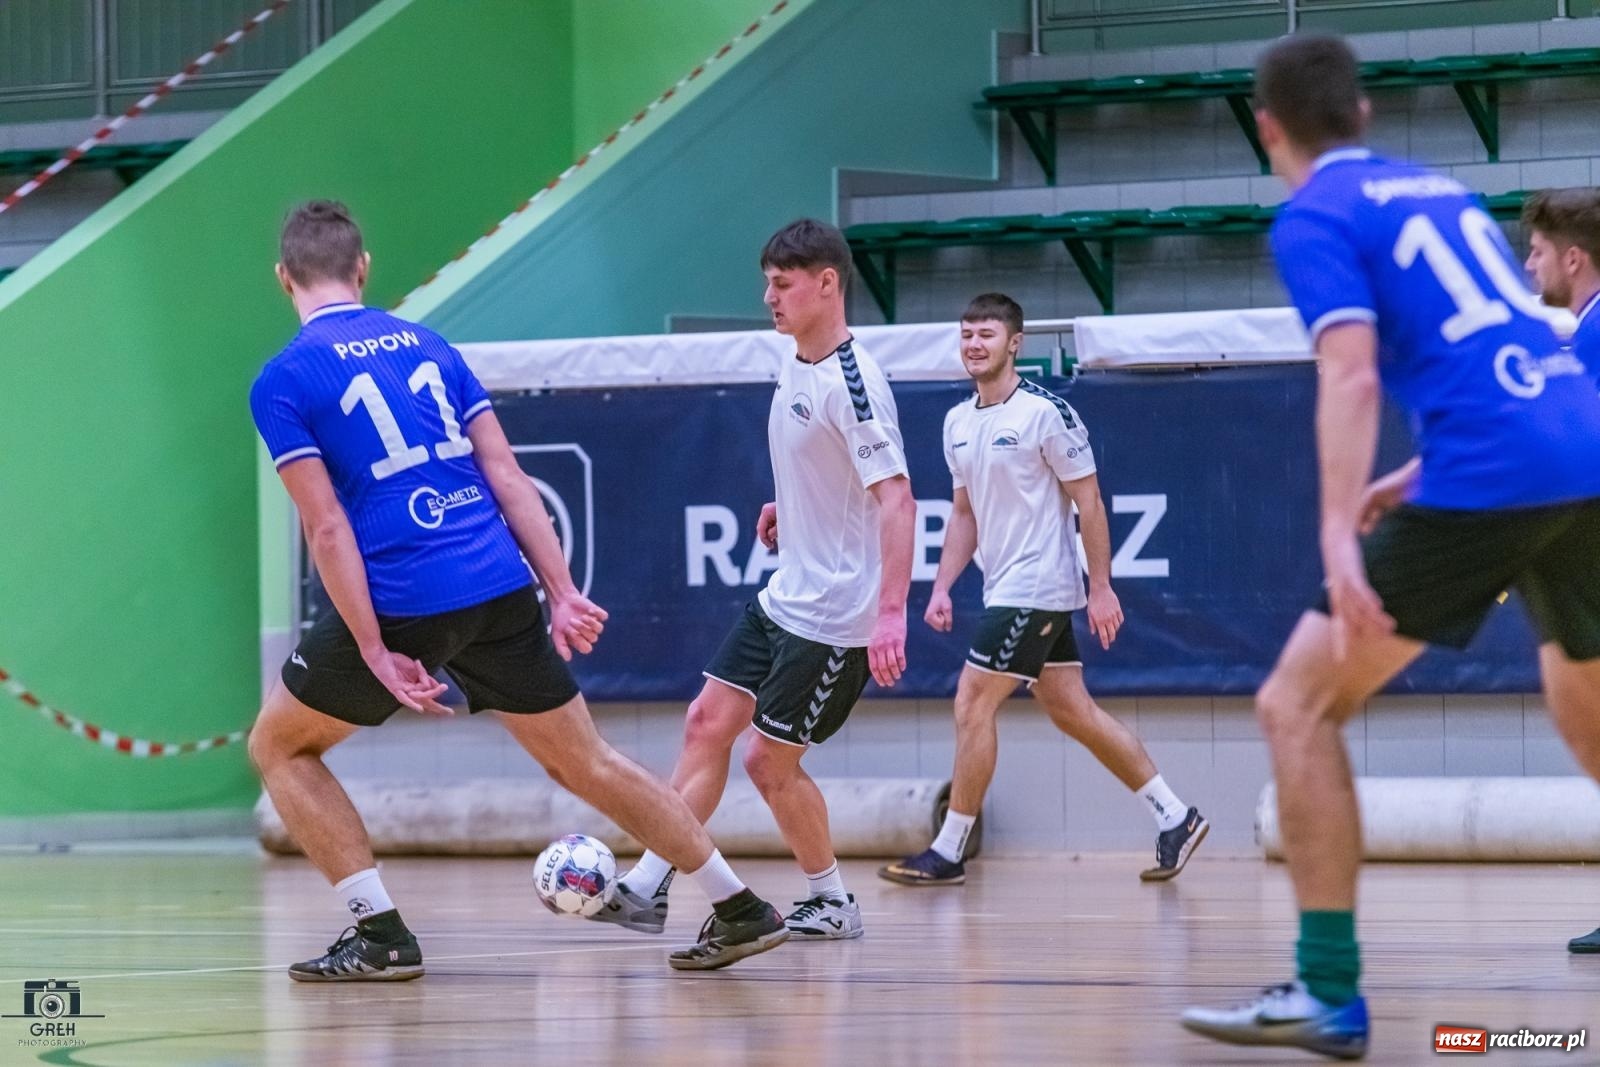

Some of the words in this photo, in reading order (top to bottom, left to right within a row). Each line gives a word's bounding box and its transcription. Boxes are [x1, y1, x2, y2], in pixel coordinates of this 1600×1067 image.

[1393, 207, 1578, 341] 10
[333, 331, 420, 360] POPOW
[340, 361, 473, 480] 11
[540, 848, 564, 892] SELECT
